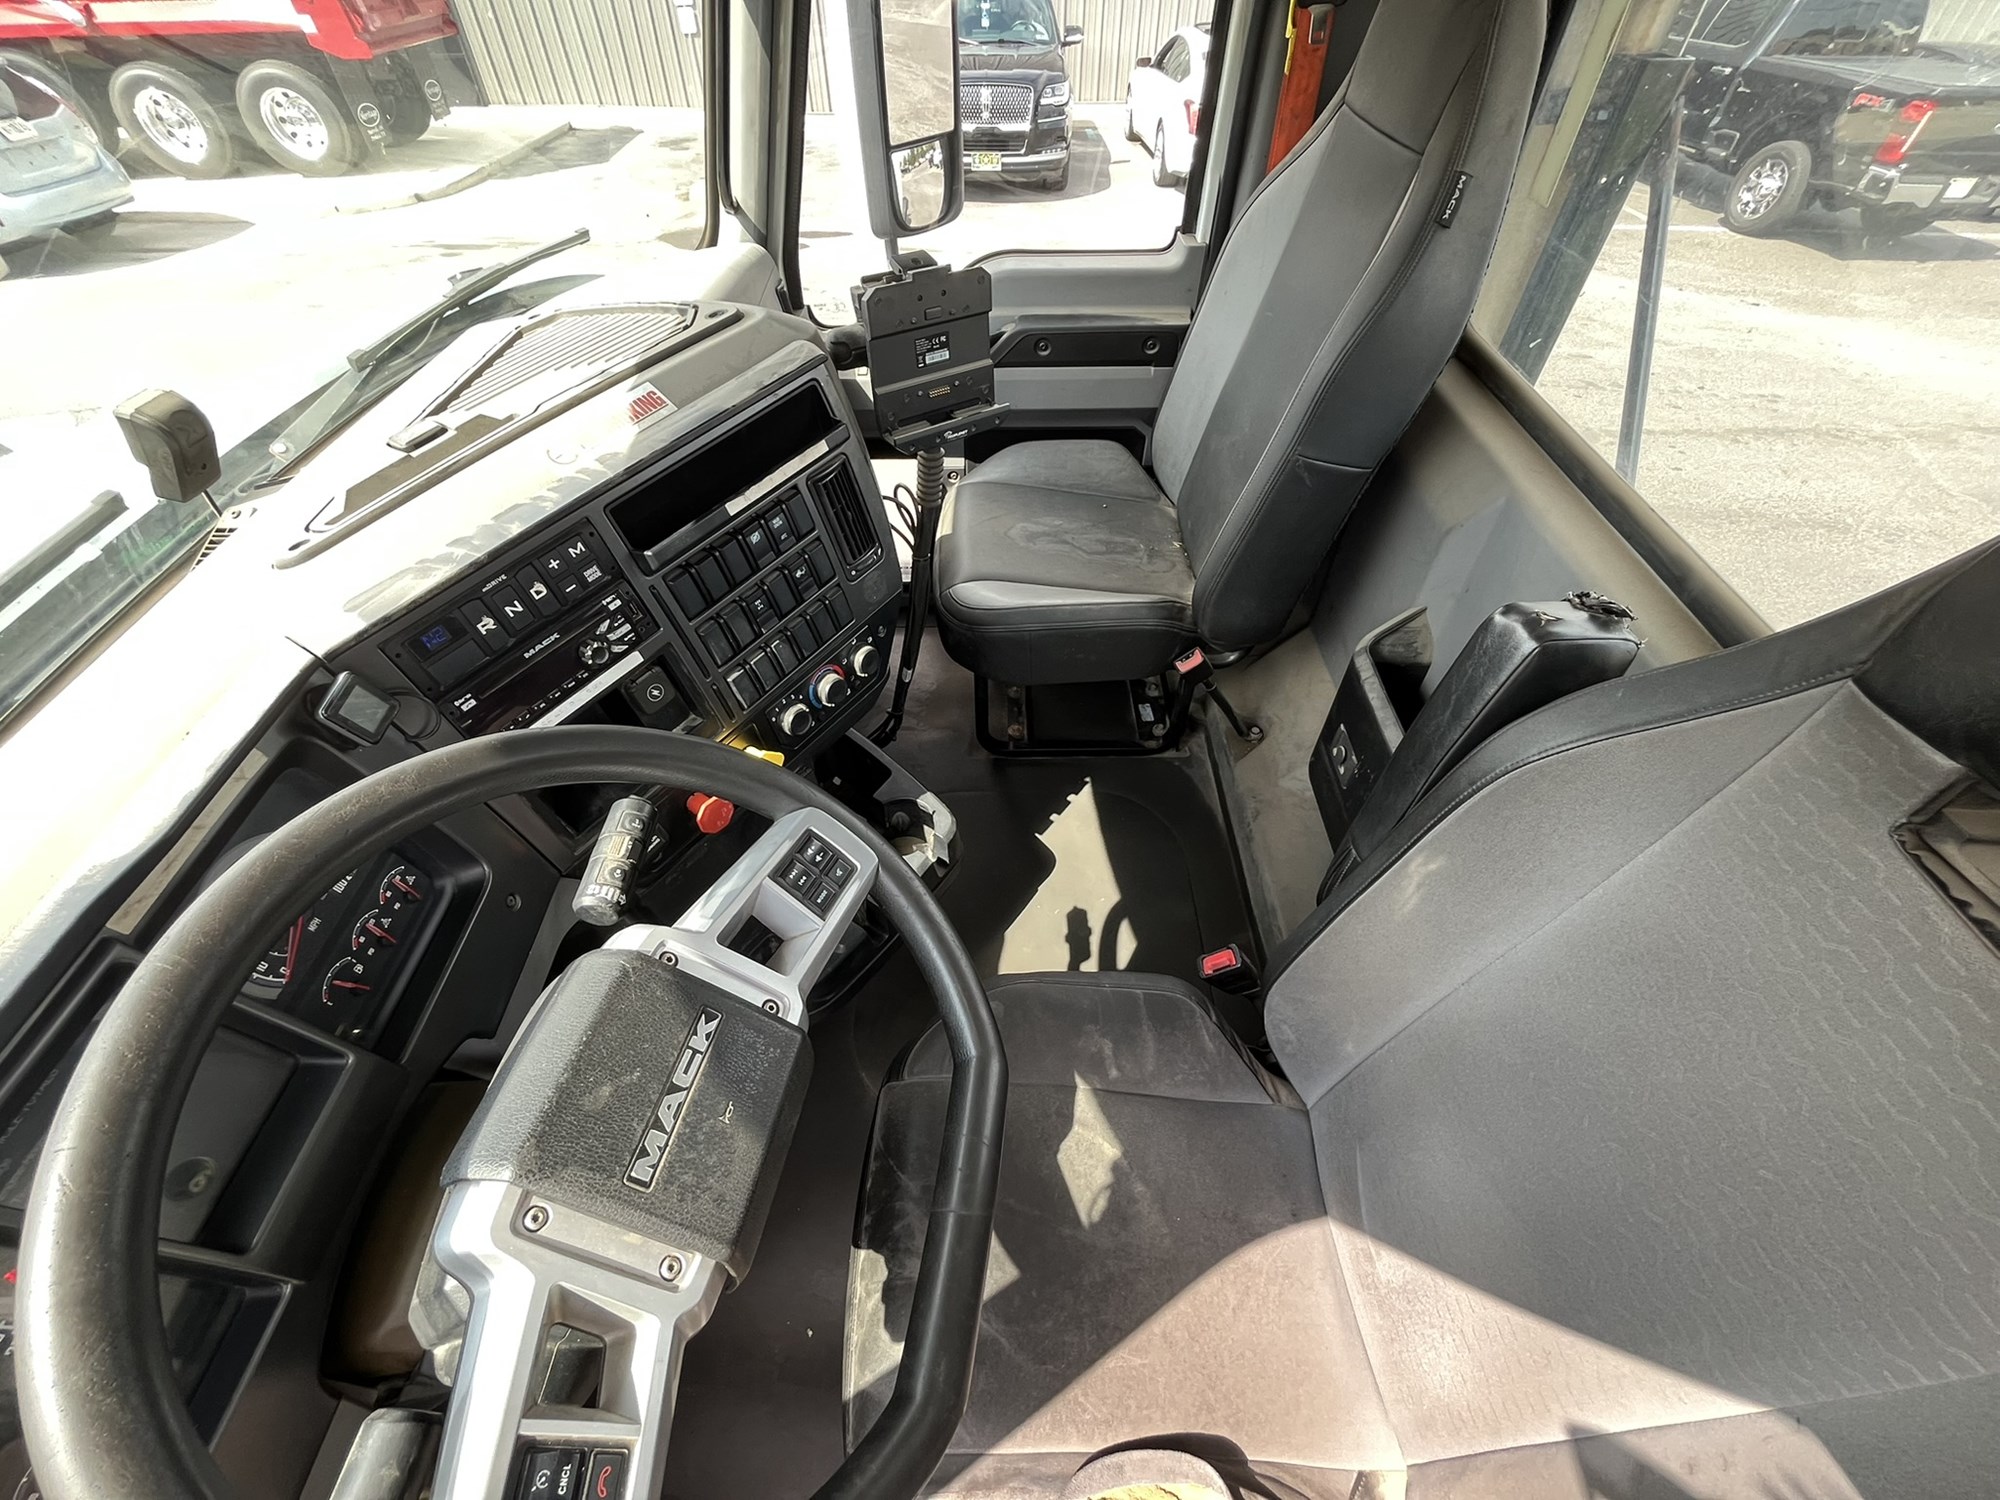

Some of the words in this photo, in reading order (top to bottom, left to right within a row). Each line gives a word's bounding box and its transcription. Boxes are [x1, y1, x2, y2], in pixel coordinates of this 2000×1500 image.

[1441, 175, 1467, 219] MACK
[628, 390, 667, 422] KING
[568, 541, 586, 558] M
[504, 600, 524, 618] N
[476, 615, 498, 635] R
[523, 631, 561, 659] MACK
[307, 916, 322, 933] MPH
[630, 1013, 721, 1183] MACK
[557, 1463, 573, 1495] CNCL
